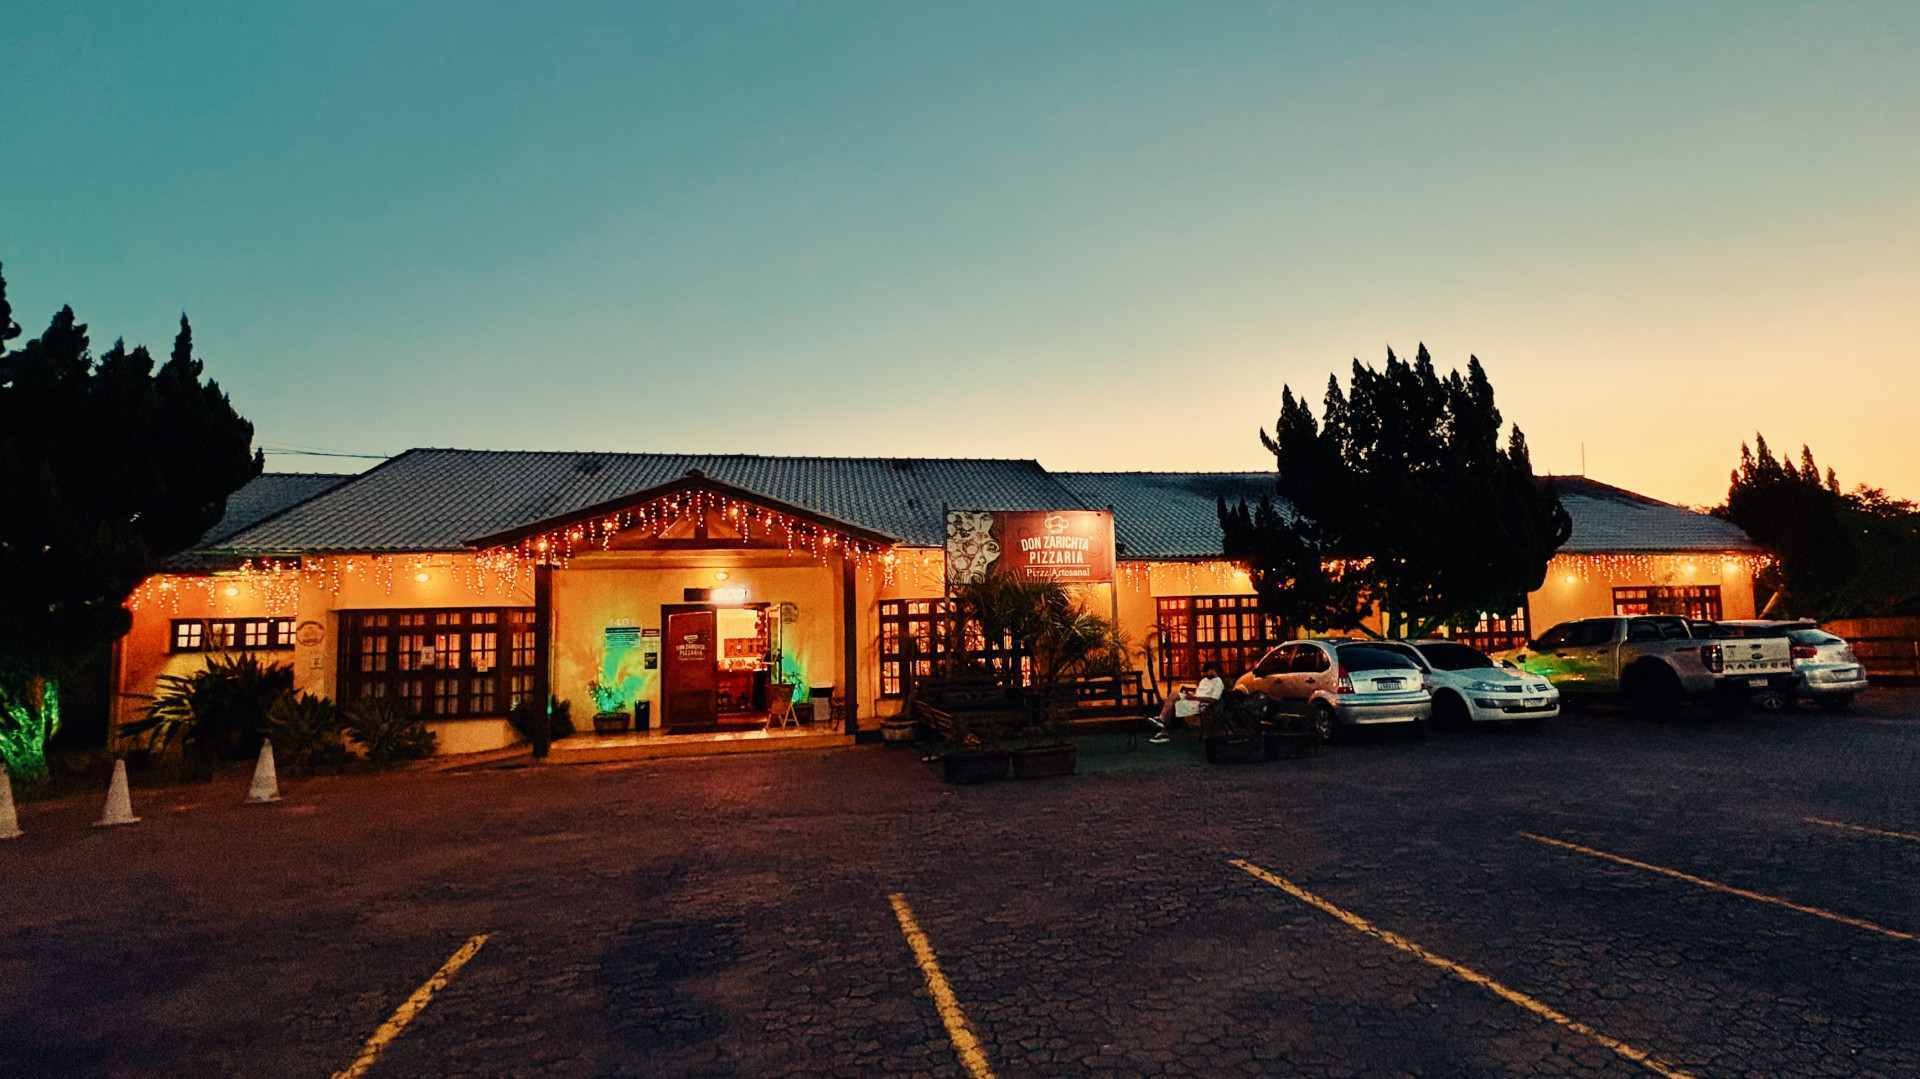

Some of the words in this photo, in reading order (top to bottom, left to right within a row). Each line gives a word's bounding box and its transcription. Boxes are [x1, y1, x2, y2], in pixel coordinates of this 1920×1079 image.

[1021, 537, 1042, 551] DON
[1044, 535, 1089, 551] ZARICHTA
[1029, 551, 1084, 564] PIZZARIA
